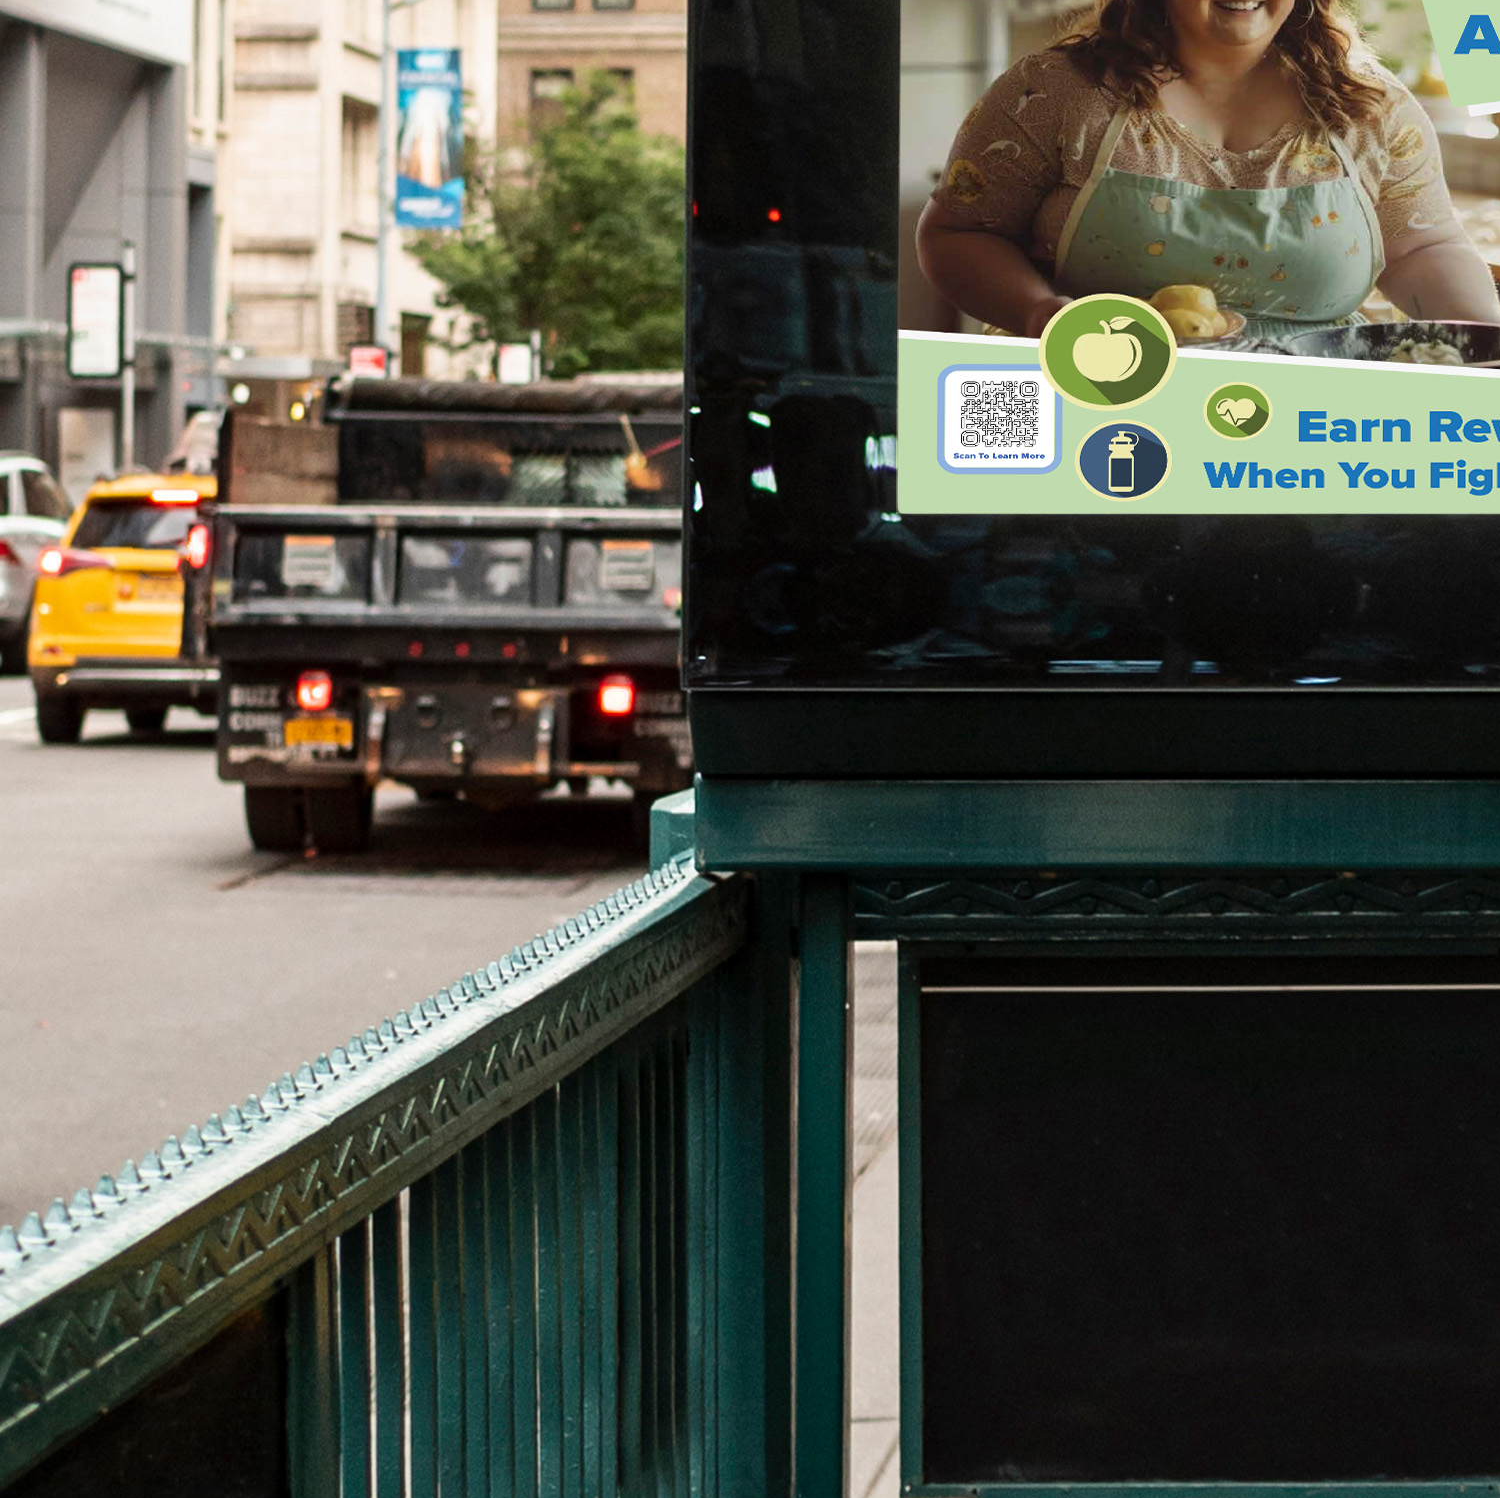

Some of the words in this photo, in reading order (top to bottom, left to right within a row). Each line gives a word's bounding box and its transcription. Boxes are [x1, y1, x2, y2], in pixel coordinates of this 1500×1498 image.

[1298, 410, 1412, 443] Earn
[953, 452, 976, 460] Scan
[978, 452, 990, 460] To
[992, 452, 1019, 460] Learn
[1021, 452, 1046, 460] More
[1203, 461, 1325, 489] When
[1337, 461, 1416, 490] You
